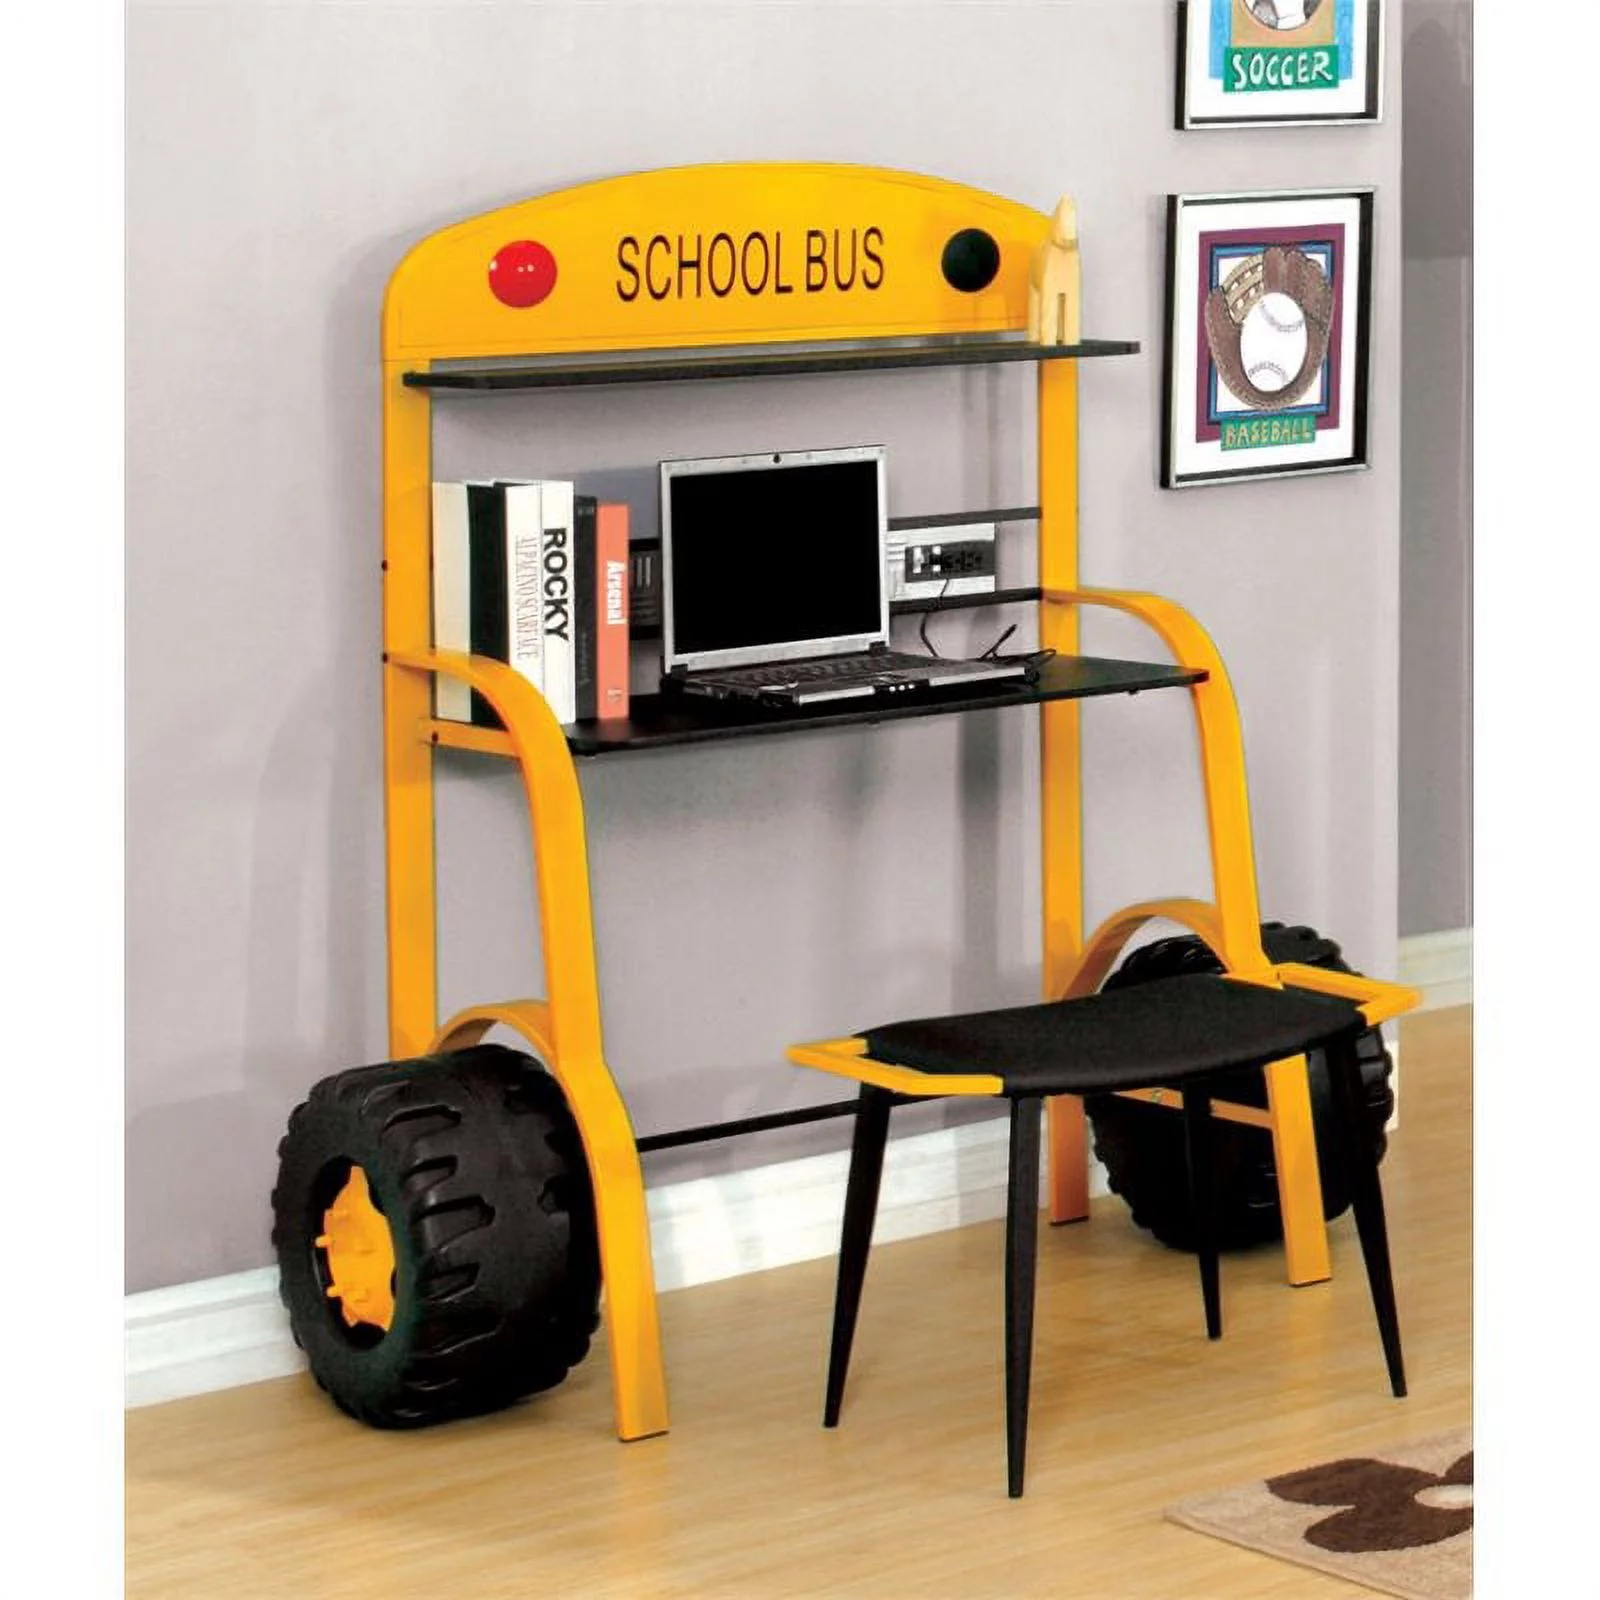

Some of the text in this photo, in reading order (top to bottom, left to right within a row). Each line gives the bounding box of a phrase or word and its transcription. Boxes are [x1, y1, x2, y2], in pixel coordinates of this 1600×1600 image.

[1232, 50, 1333, 90] SOCCER
[616, 226, 885, 302] SCHOOL BUS
[1225, 418, 1311, 446] BASEBALL
[543, 528, 569, 641] ROCKY
[607, 560, 626, 625] Arsenal
